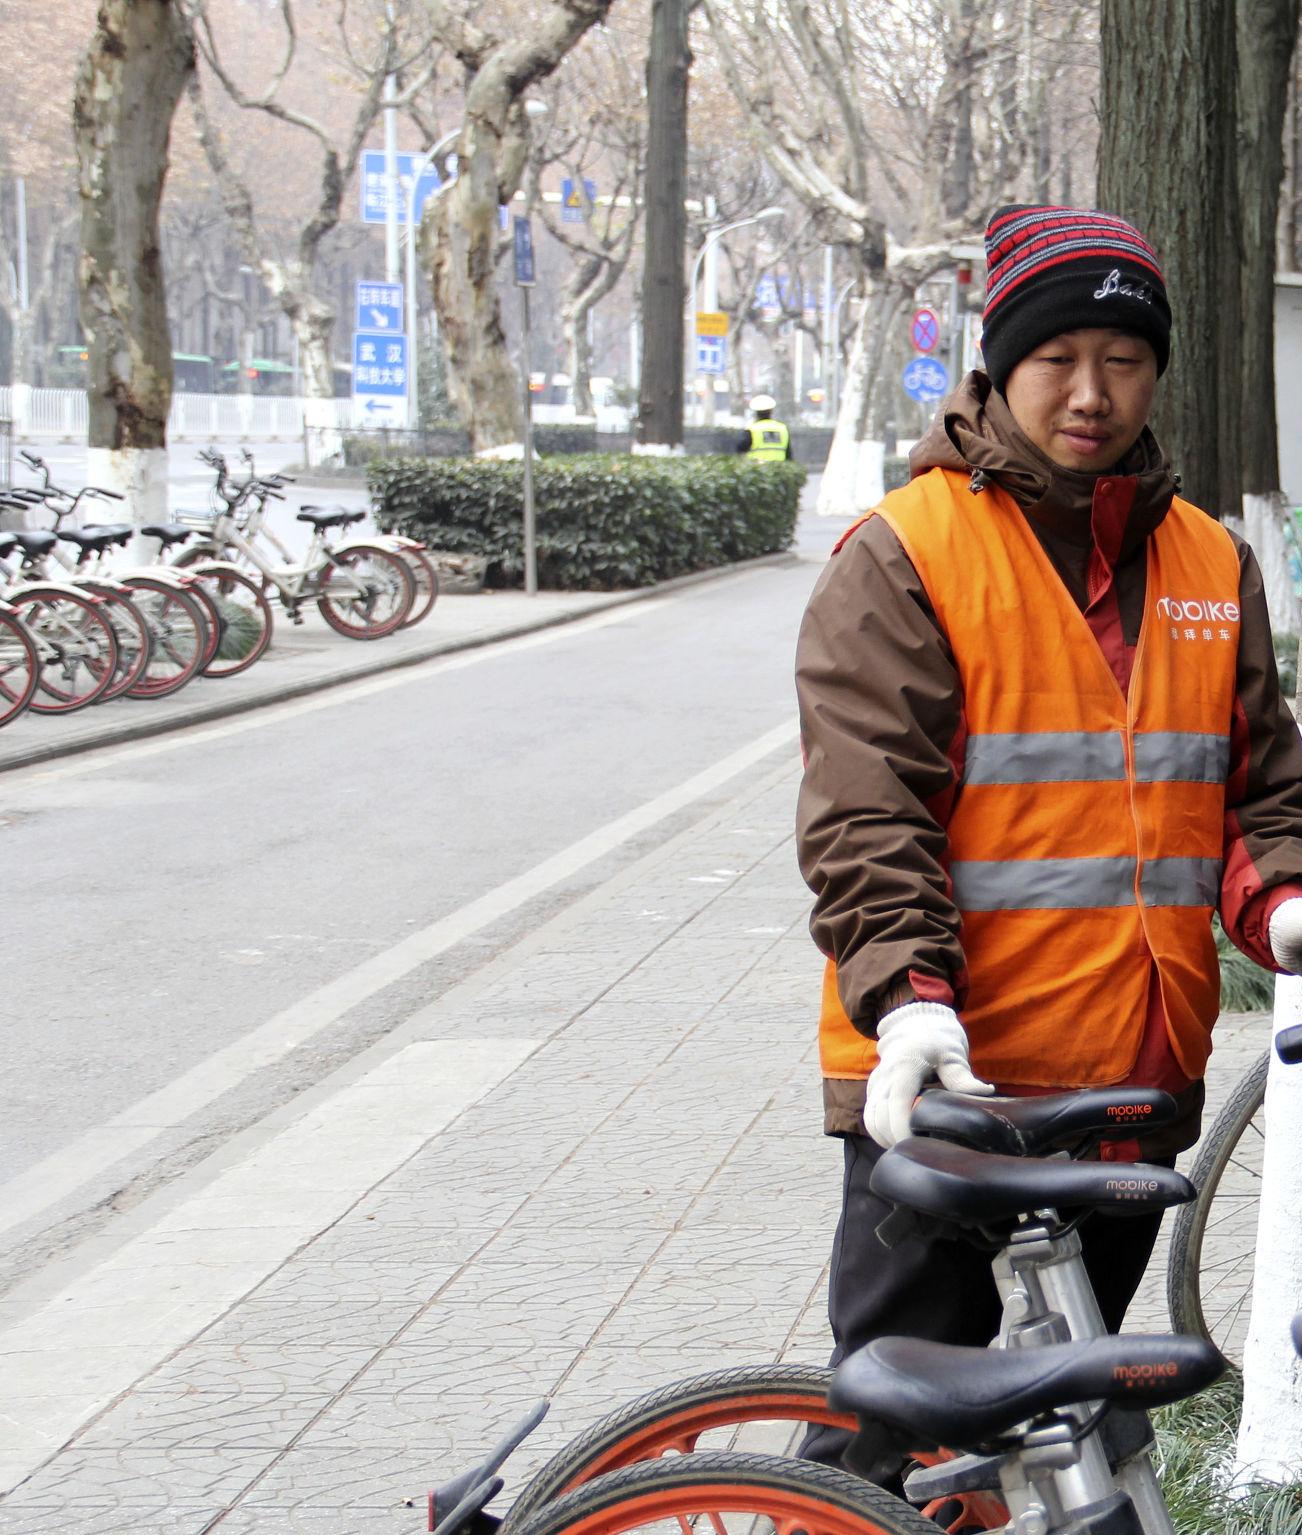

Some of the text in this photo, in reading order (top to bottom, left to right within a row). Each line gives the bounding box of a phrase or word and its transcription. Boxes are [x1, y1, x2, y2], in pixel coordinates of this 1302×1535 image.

[1107, 1104, 1152, 1116] mobike
[1106, 1180, 1158, 1191] mobike
[1113, 1361, 1178, 1379] mobike
